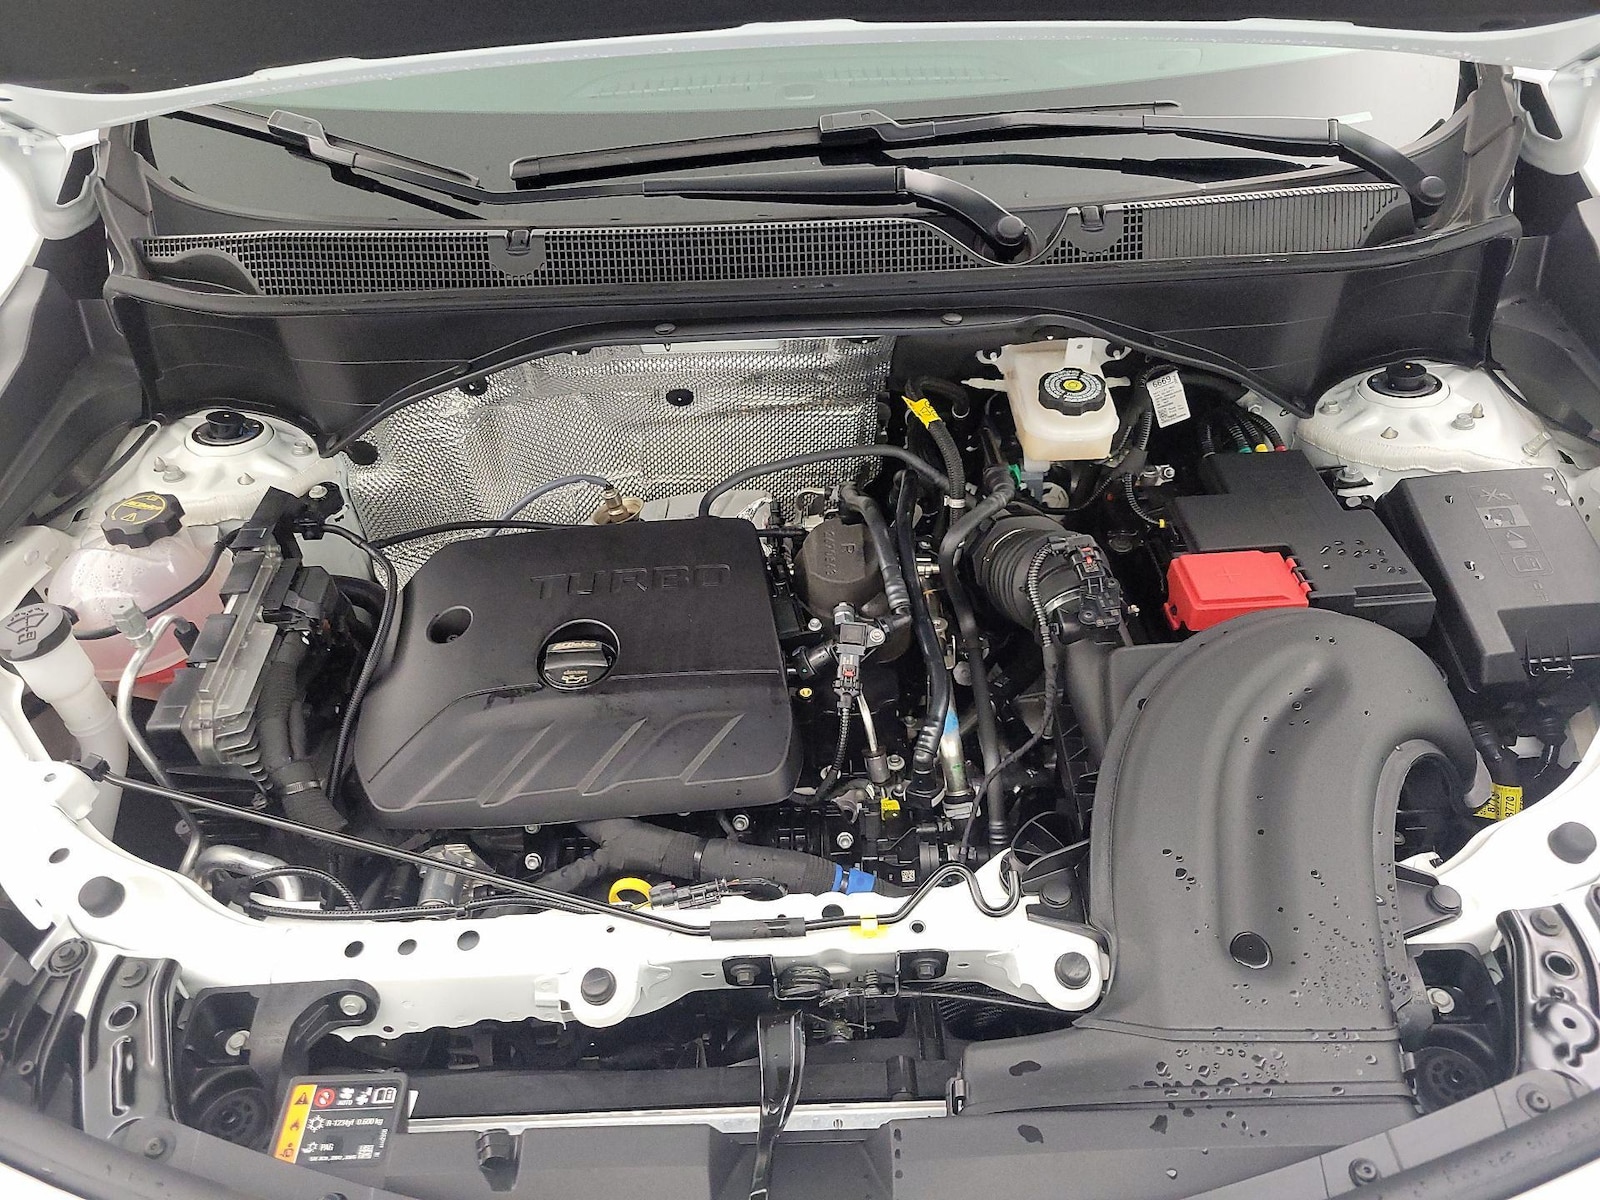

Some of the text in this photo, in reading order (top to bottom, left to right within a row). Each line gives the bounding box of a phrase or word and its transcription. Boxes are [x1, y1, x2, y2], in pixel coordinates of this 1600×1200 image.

[1152, 375, 1172, 388] 6669
[530, 563, 732, 599] TURBO
[552, 642, 597, 650] ACDelco
[320, 1143, 335, 1151] PAG
